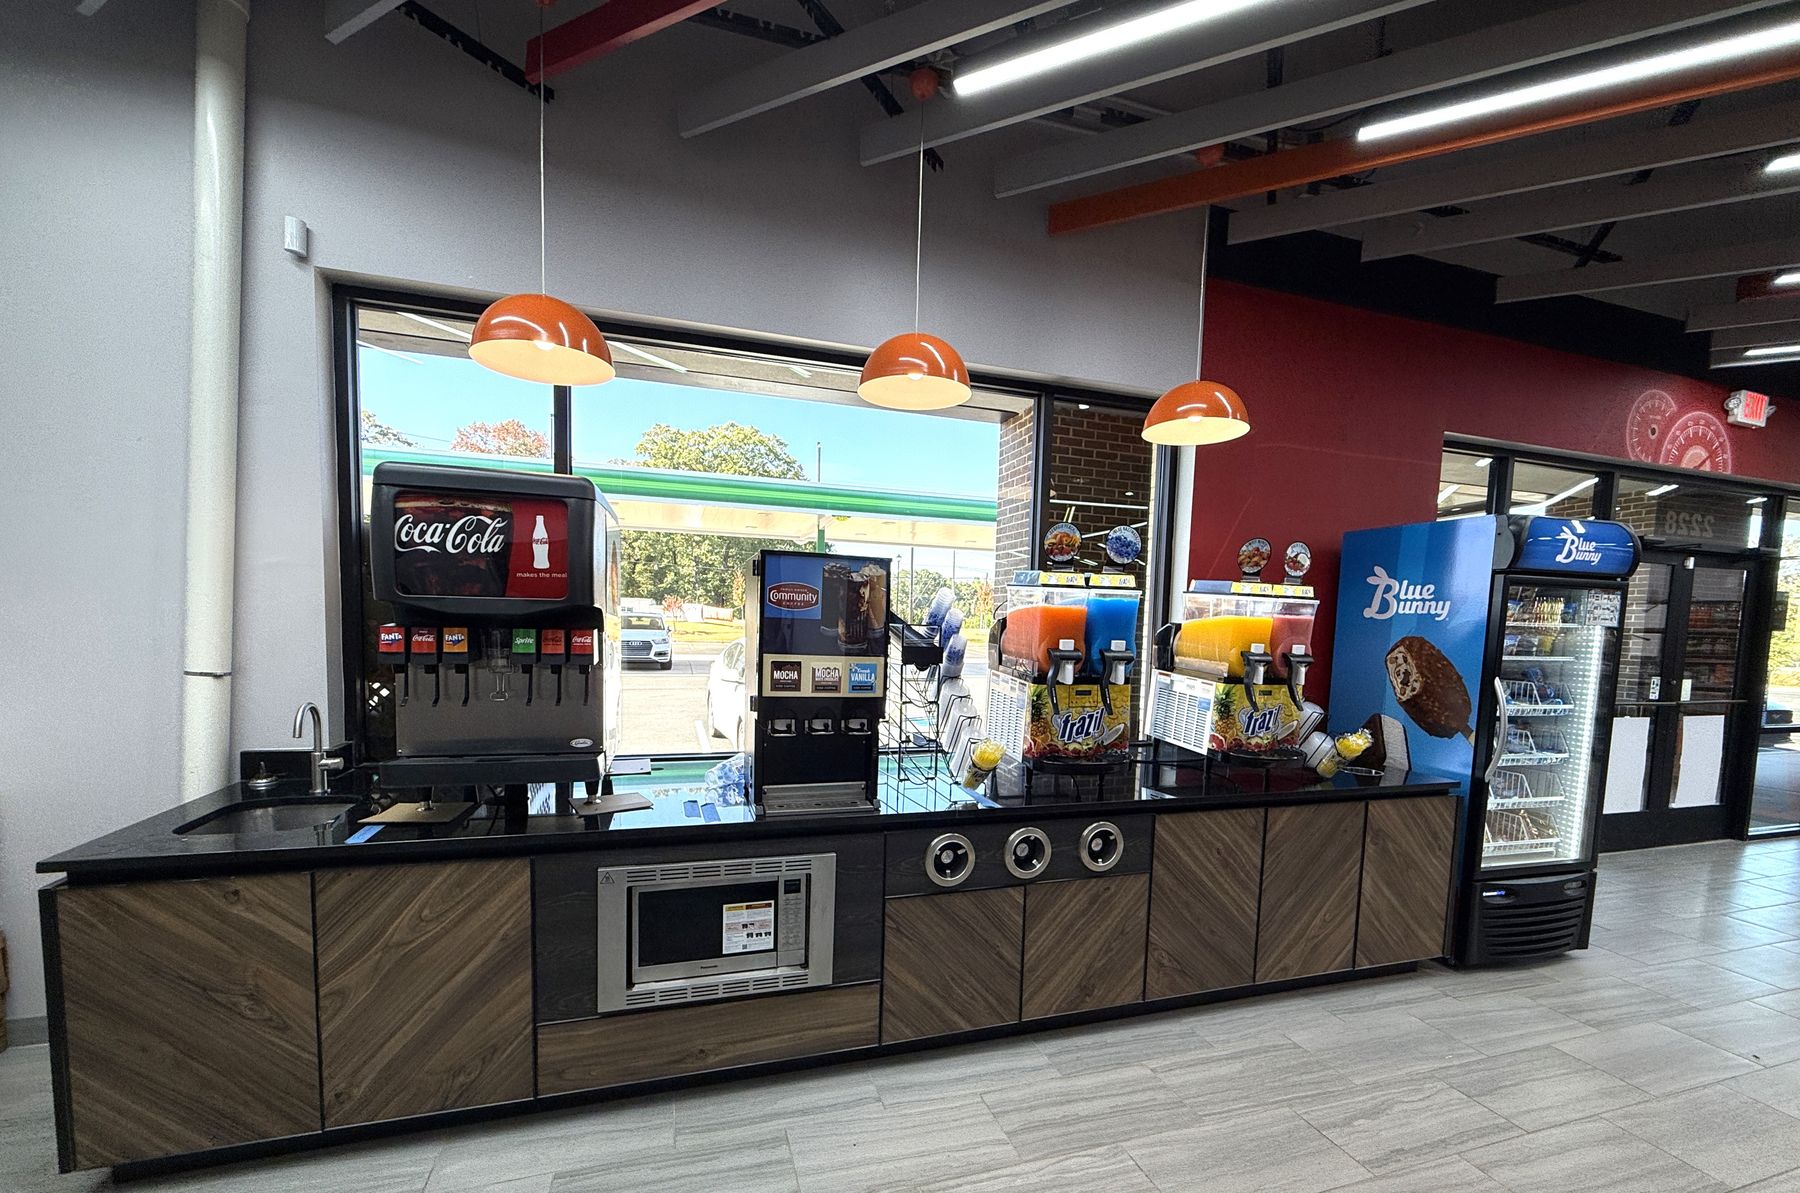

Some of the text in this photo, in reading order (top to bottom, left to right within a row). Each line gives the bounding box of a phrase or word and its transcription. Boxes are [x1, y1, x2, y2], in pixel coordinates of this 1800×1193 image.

[394, 514, 508, 554] Coca-Cola
[1554, 526, 1597, 562] Blue
[770, 589, 818, 604] Community
[1363, 566, 1436, 617] Blue
[514, 636, 534, 645] Sprite
[773, 670, 799, 680] MOCHA
[815, 667, 839, 679] MOCHA
[850, 672, 876, 682] VANILLA
